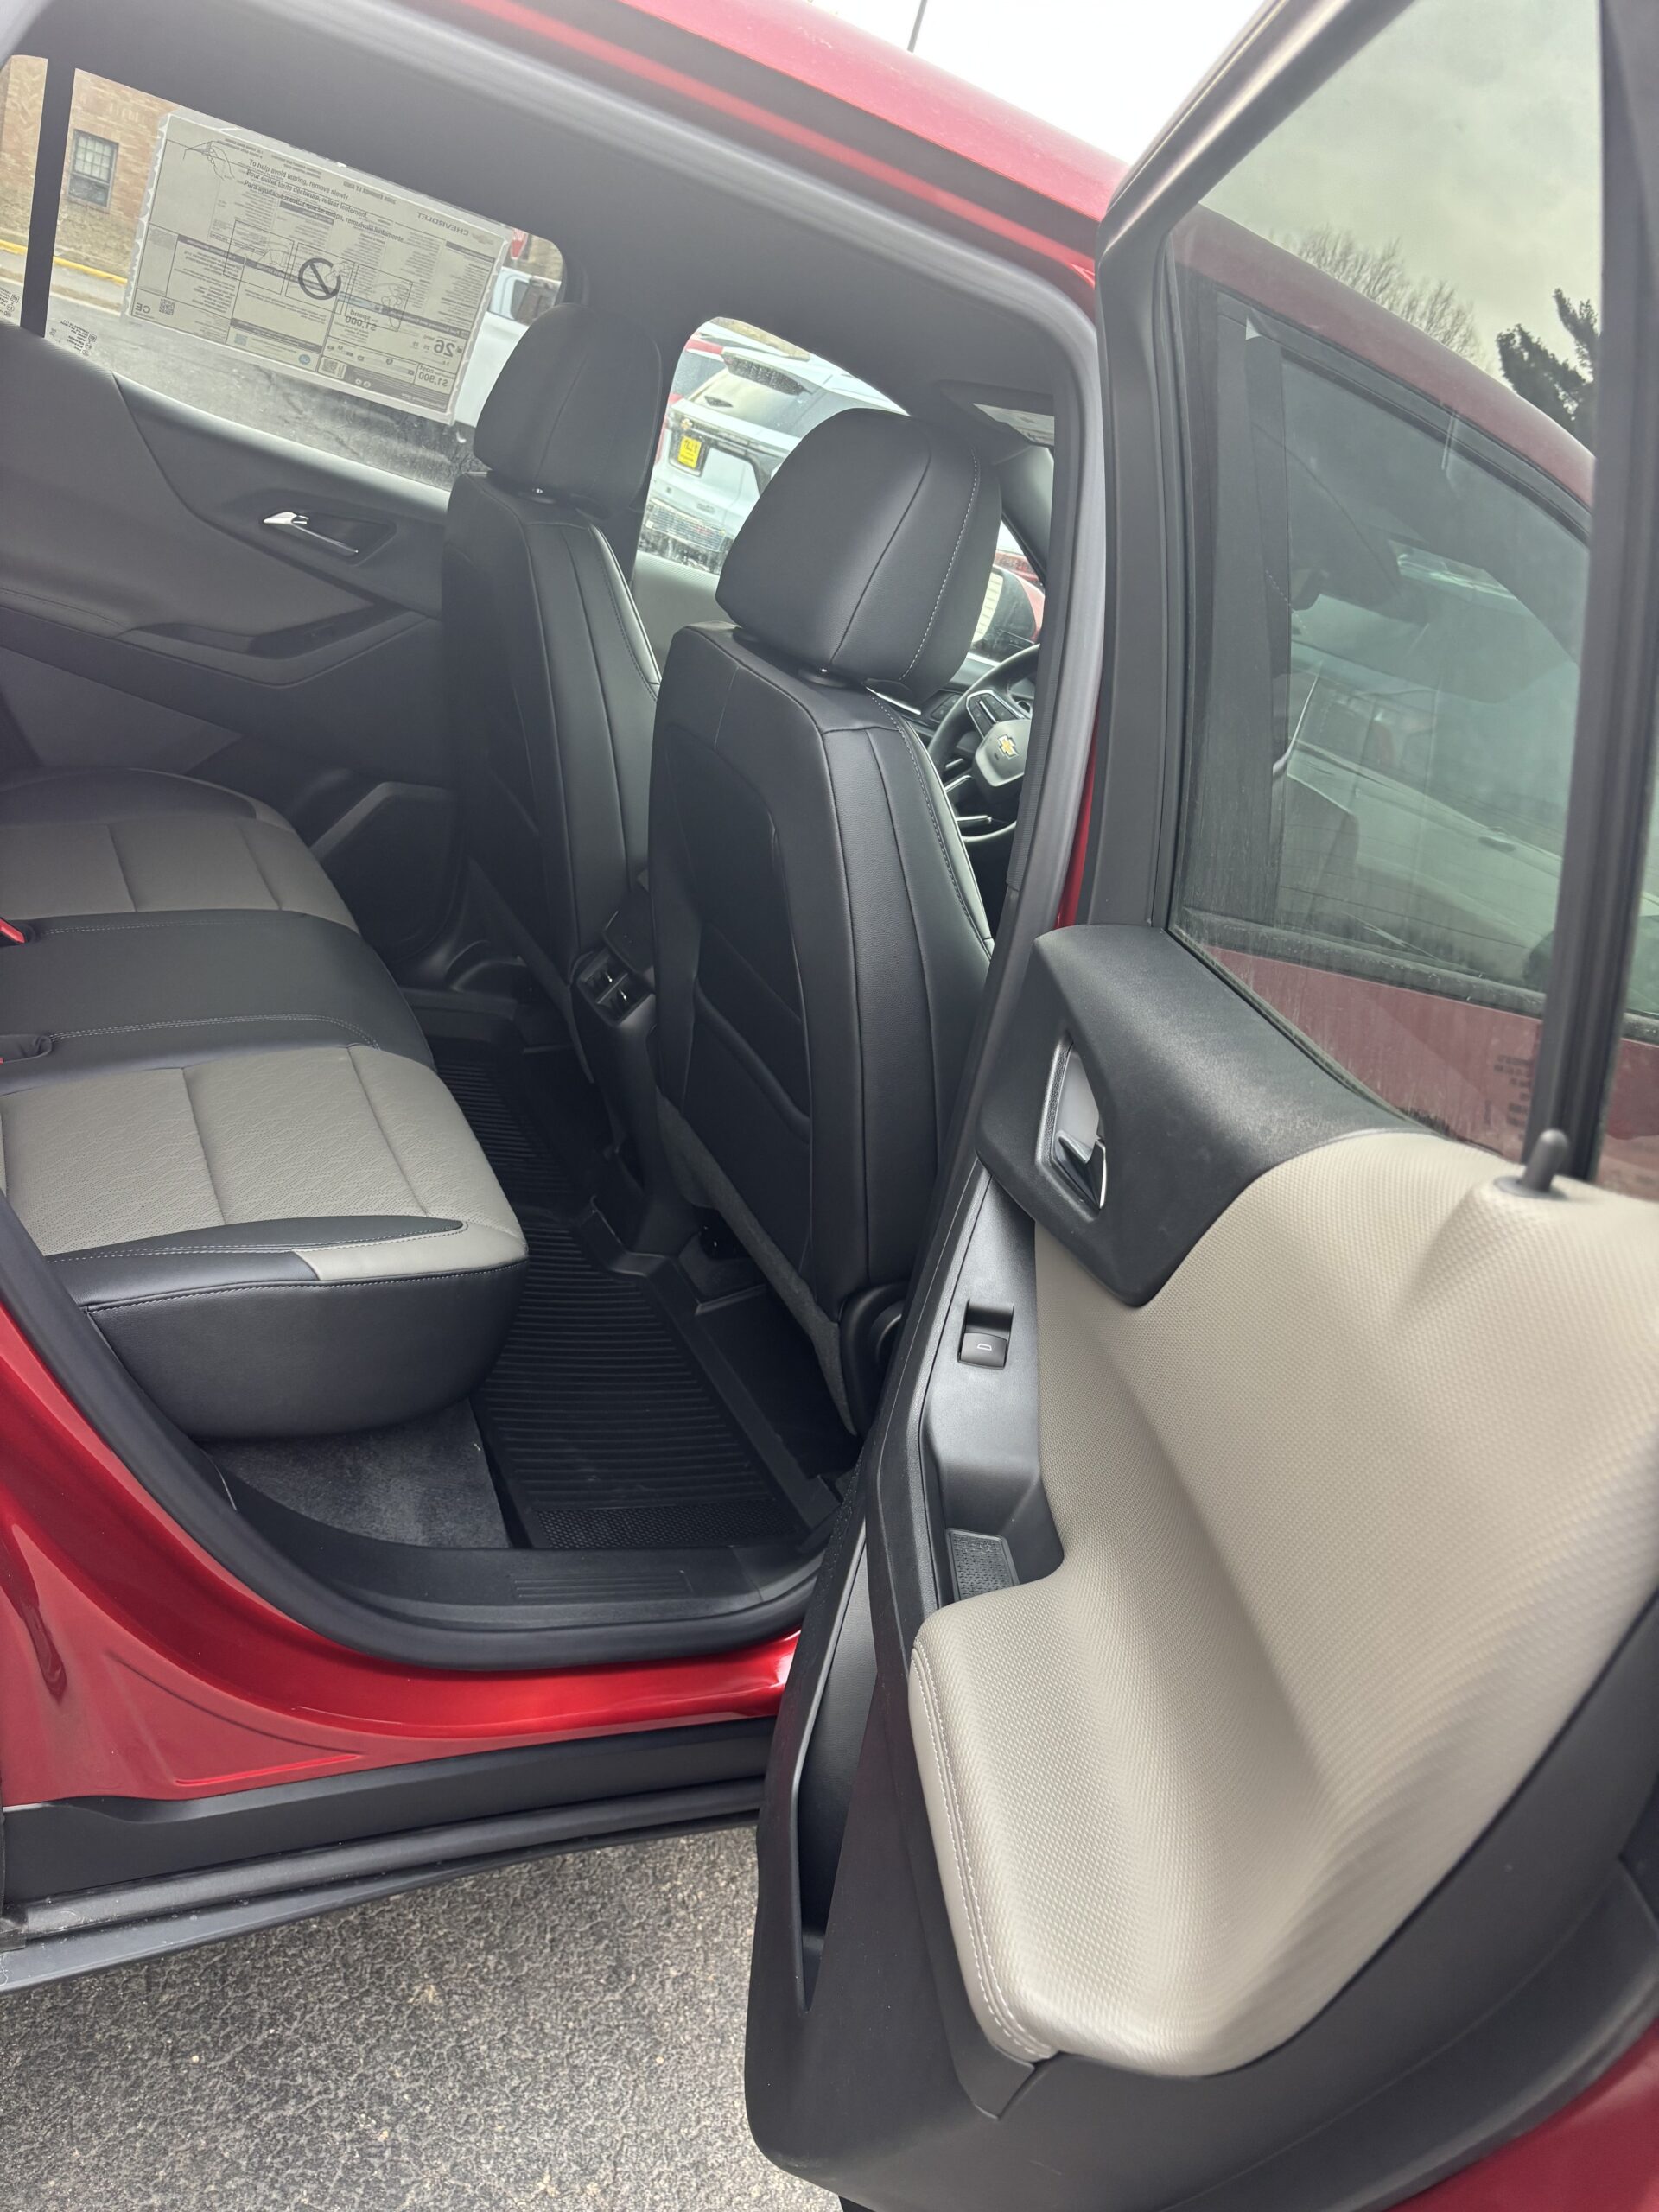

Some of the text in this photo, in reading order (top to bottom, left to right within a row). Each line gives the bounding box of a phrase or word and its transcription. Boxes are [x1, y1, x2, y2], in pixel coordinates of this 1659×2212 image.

[245, 168, 260, 180] Pour
[248, 158, 257, 167] To
[256, 162, 270, 173] help
[270, 166, 287, 178] avoid
[286, 172, 308, 186] tearing,
[308, 180, 330, 193] remove
[329, 188, 350, 202] slowly.
[243, 179, 258, 190] Para
